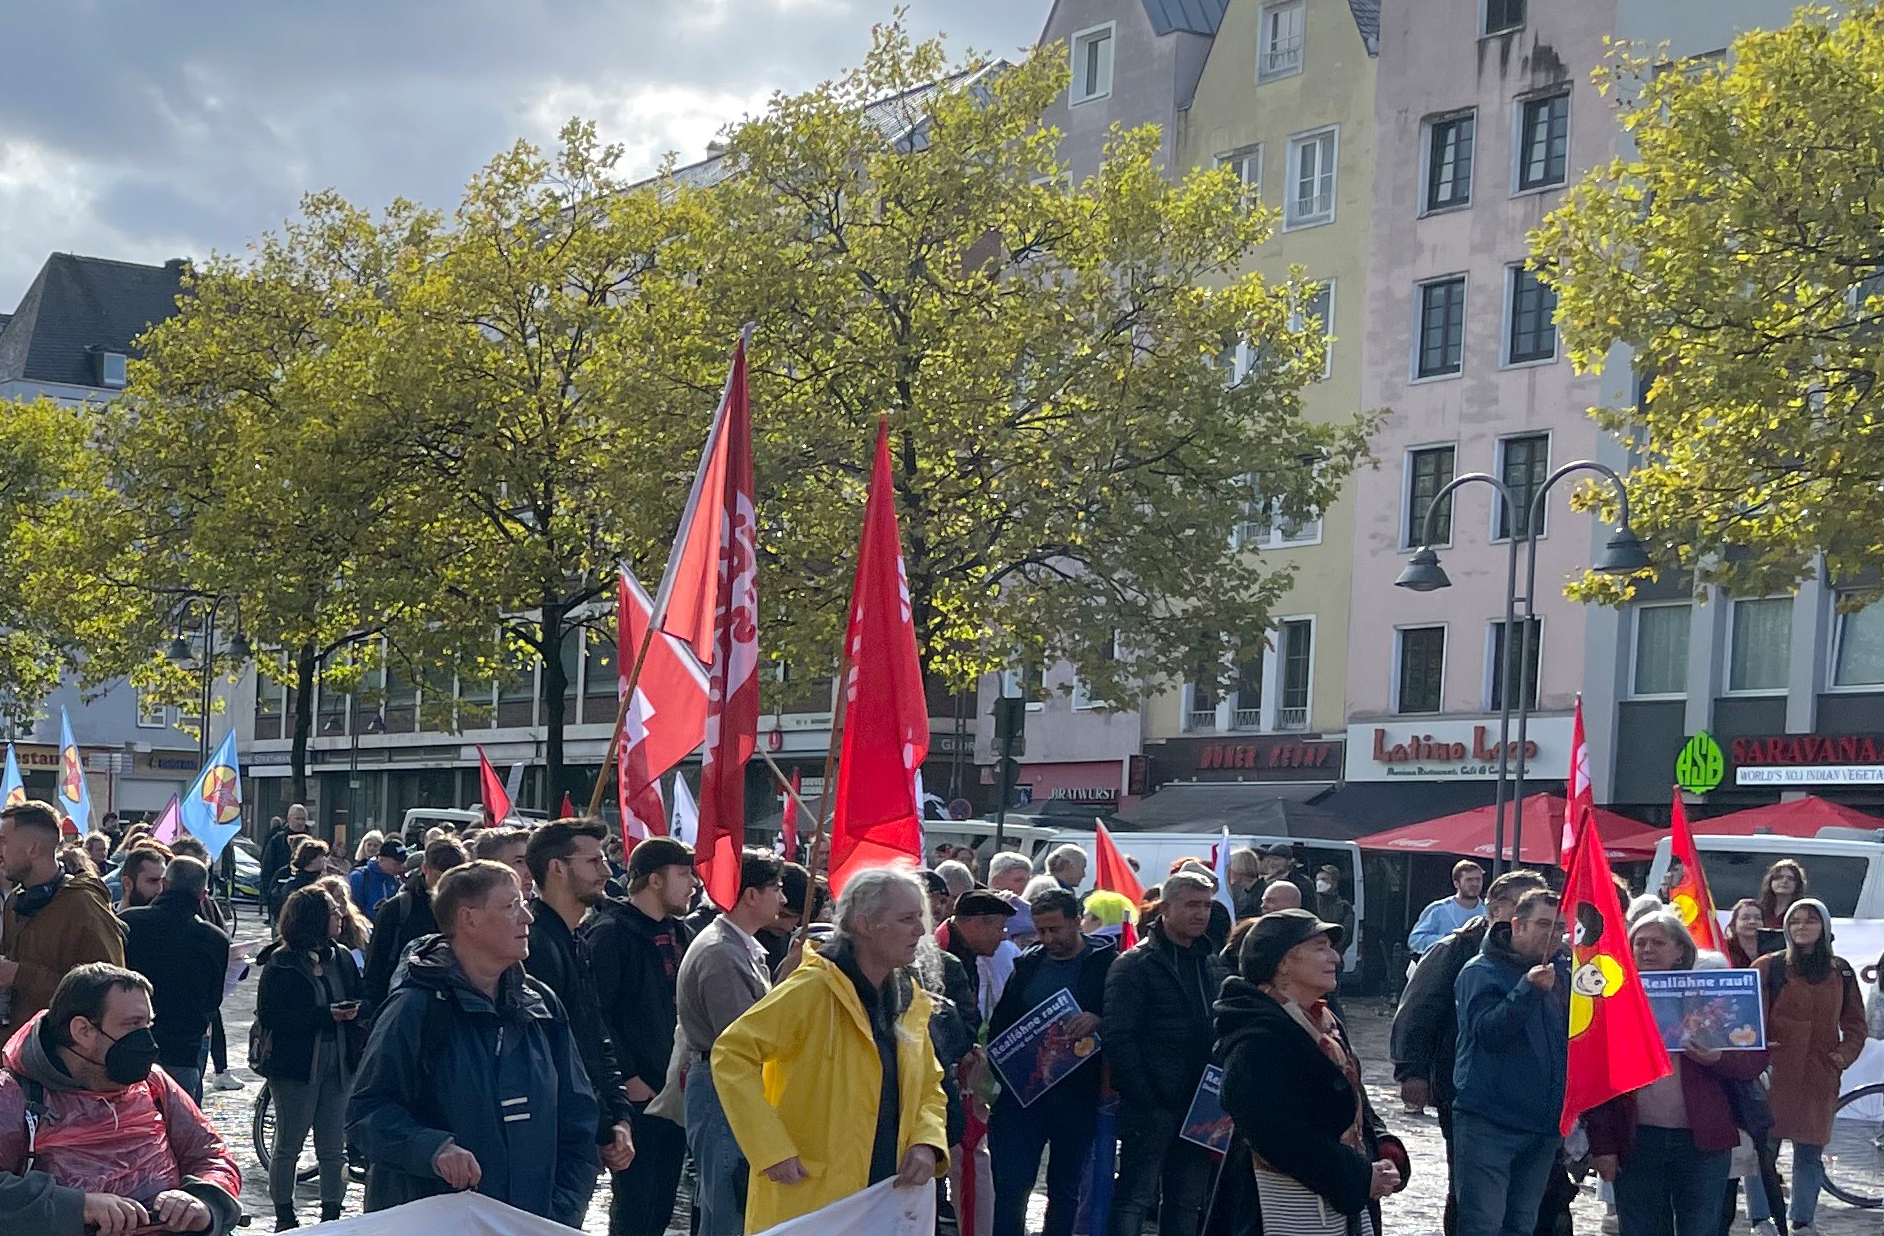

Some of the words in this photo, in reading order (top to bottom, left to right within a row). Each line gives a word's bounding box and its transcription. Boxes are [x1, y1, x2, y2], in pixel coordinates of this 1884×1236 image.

[1373, 728, 1466, 763] Latino
[1472, 725, 1538, 761] Loco
[1740, 769, 1782, 781] WORLD'S
[1805, 768, 1840, 781] INDIAN
[1049, 787, 1117, 800] BRATWURST
[1641, 976, 1716, 989] Reallöhne
[1719, 974, 1754, 987] rauf!
[990, 1015, 1042, 1059] Reallöhne
[1041, 995, 1070, 1020] rauf!
[1205, 1070, 1222, 1086] Re
